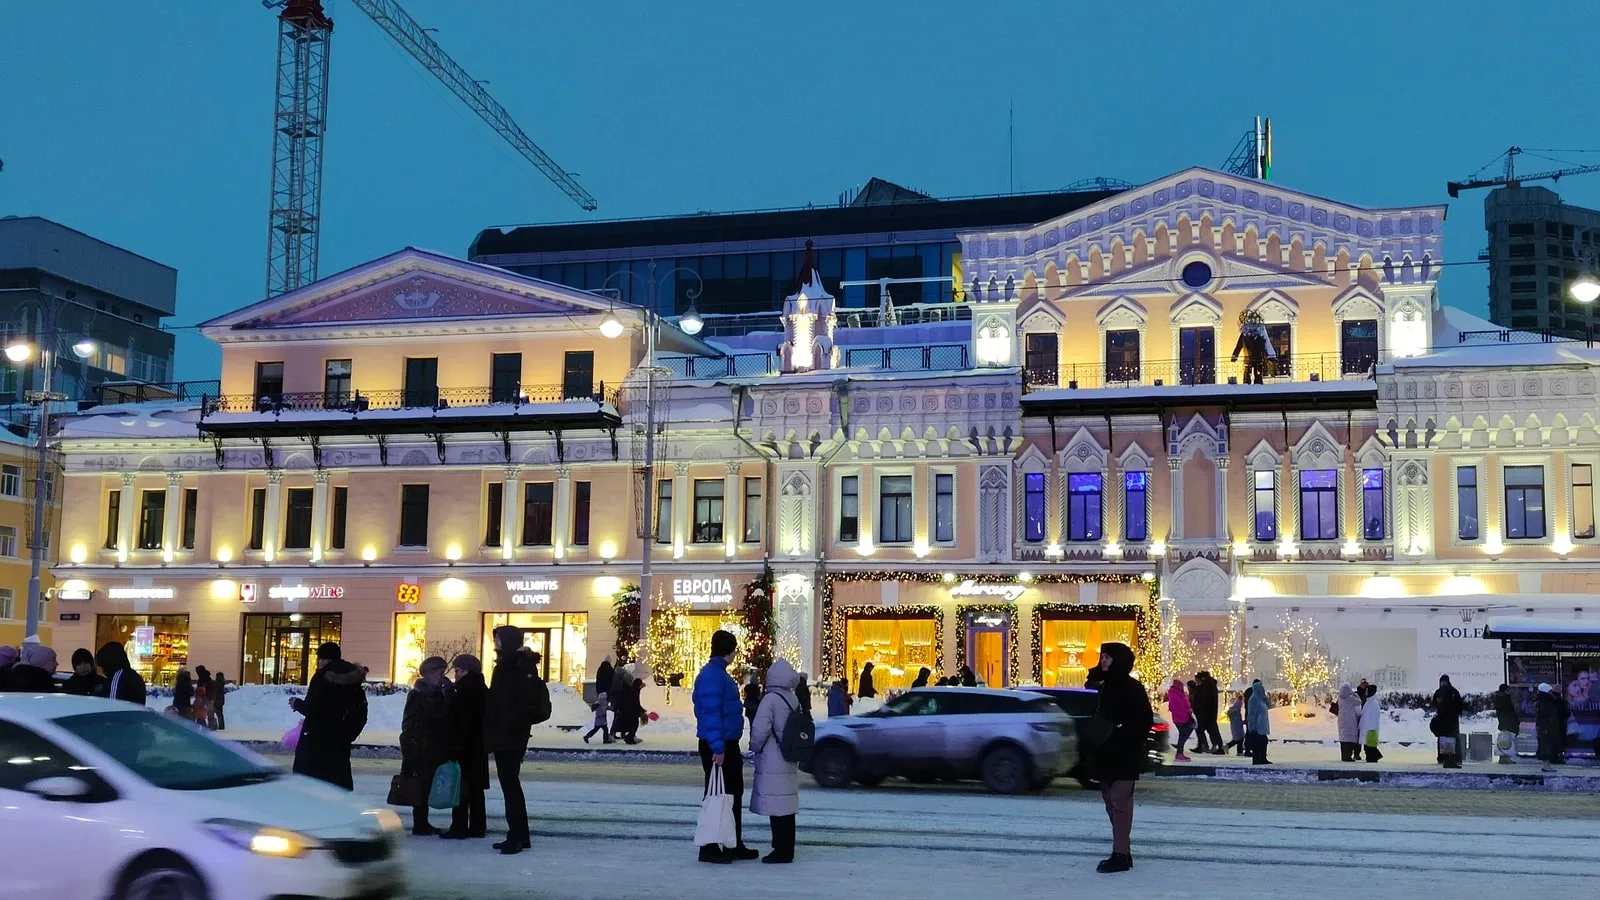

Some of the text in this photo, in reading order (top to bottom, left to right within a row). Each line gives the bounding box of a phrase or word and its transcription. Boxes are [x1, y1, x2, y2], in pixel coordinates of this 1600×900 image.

[673, 579, 732, 594] ЕВРОПА
[512, 594, 550, 605] OLIVER
[1439, 627, 1484, 639] ROLE
